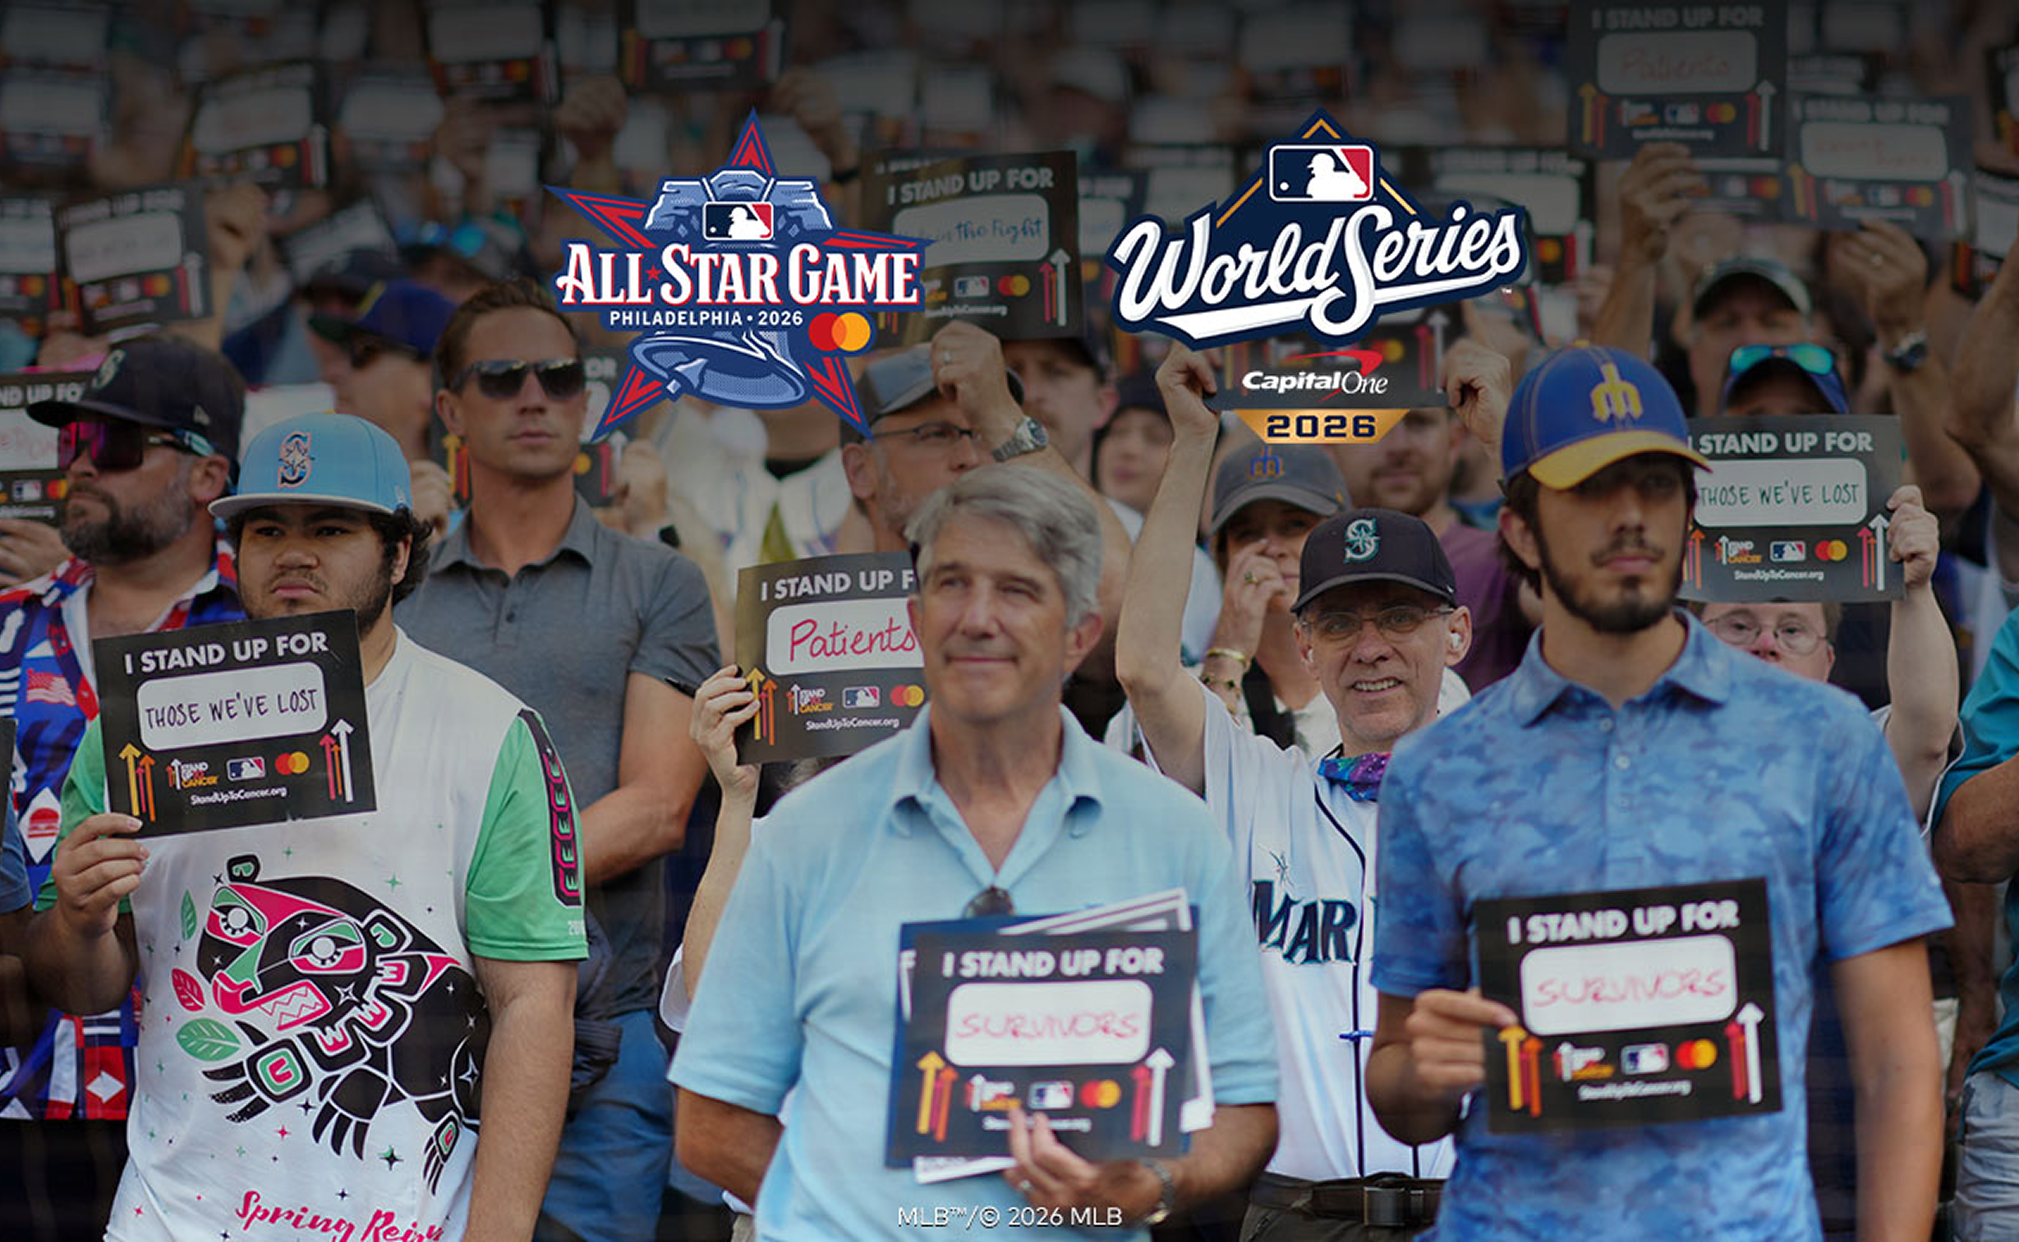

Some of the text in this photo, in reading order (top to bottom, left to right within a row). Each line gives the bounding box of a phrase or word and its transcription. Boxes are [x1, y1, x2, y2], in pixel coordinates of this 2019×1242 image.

[1605, 8, 1678, 29] STAND
[1682, 7, 1715, 27] UP
[1718, 6, 1764, 27] FOR
[900, 174, 964, 204] STAND
[968, 169, 1002, 191] UP
[1005, 167, 1055, 190] FOR
[585, 356, 617, 378] OR
[56, 382, 84, 402] FO
[1699, 432, 1779, 455] STAND
[1785, 432, 1819, 454] UP
[1824, 431, 1873, 453] FOR
[1700, 477, 1860, 506] THOSE WE'VE LOST
[761, 582, 768, 601] I
[774, 573, 852, 600] STAND
[859, 570, 894, 591] UP
[125, 632, 329, 675] I STAND UP FOR
[789, 617, 916, 662] Patients
[145, 689, 318, 729] THOSE WE'VE LOST
[806, 717, 900, 731] StandUpToCancer.org
[190, 787, 287, 805] StandUpToCancer.org
[1251, 878, 1378, 966] MAR
[1508, 900, 1740, 944] I STAND UP FOR
[944, 952, 953, 977] I
[960, 951, 1056, 977] STAND
[1060, 950, 1100, 976] UP
[1104, 948, 1164, 975] FOR
[1532, 967, 1728, 1009] SURVIVORS
[954, 1010, 1141, 1040] SURVIVORS
[235, 1190, 356, 1242] Spring
